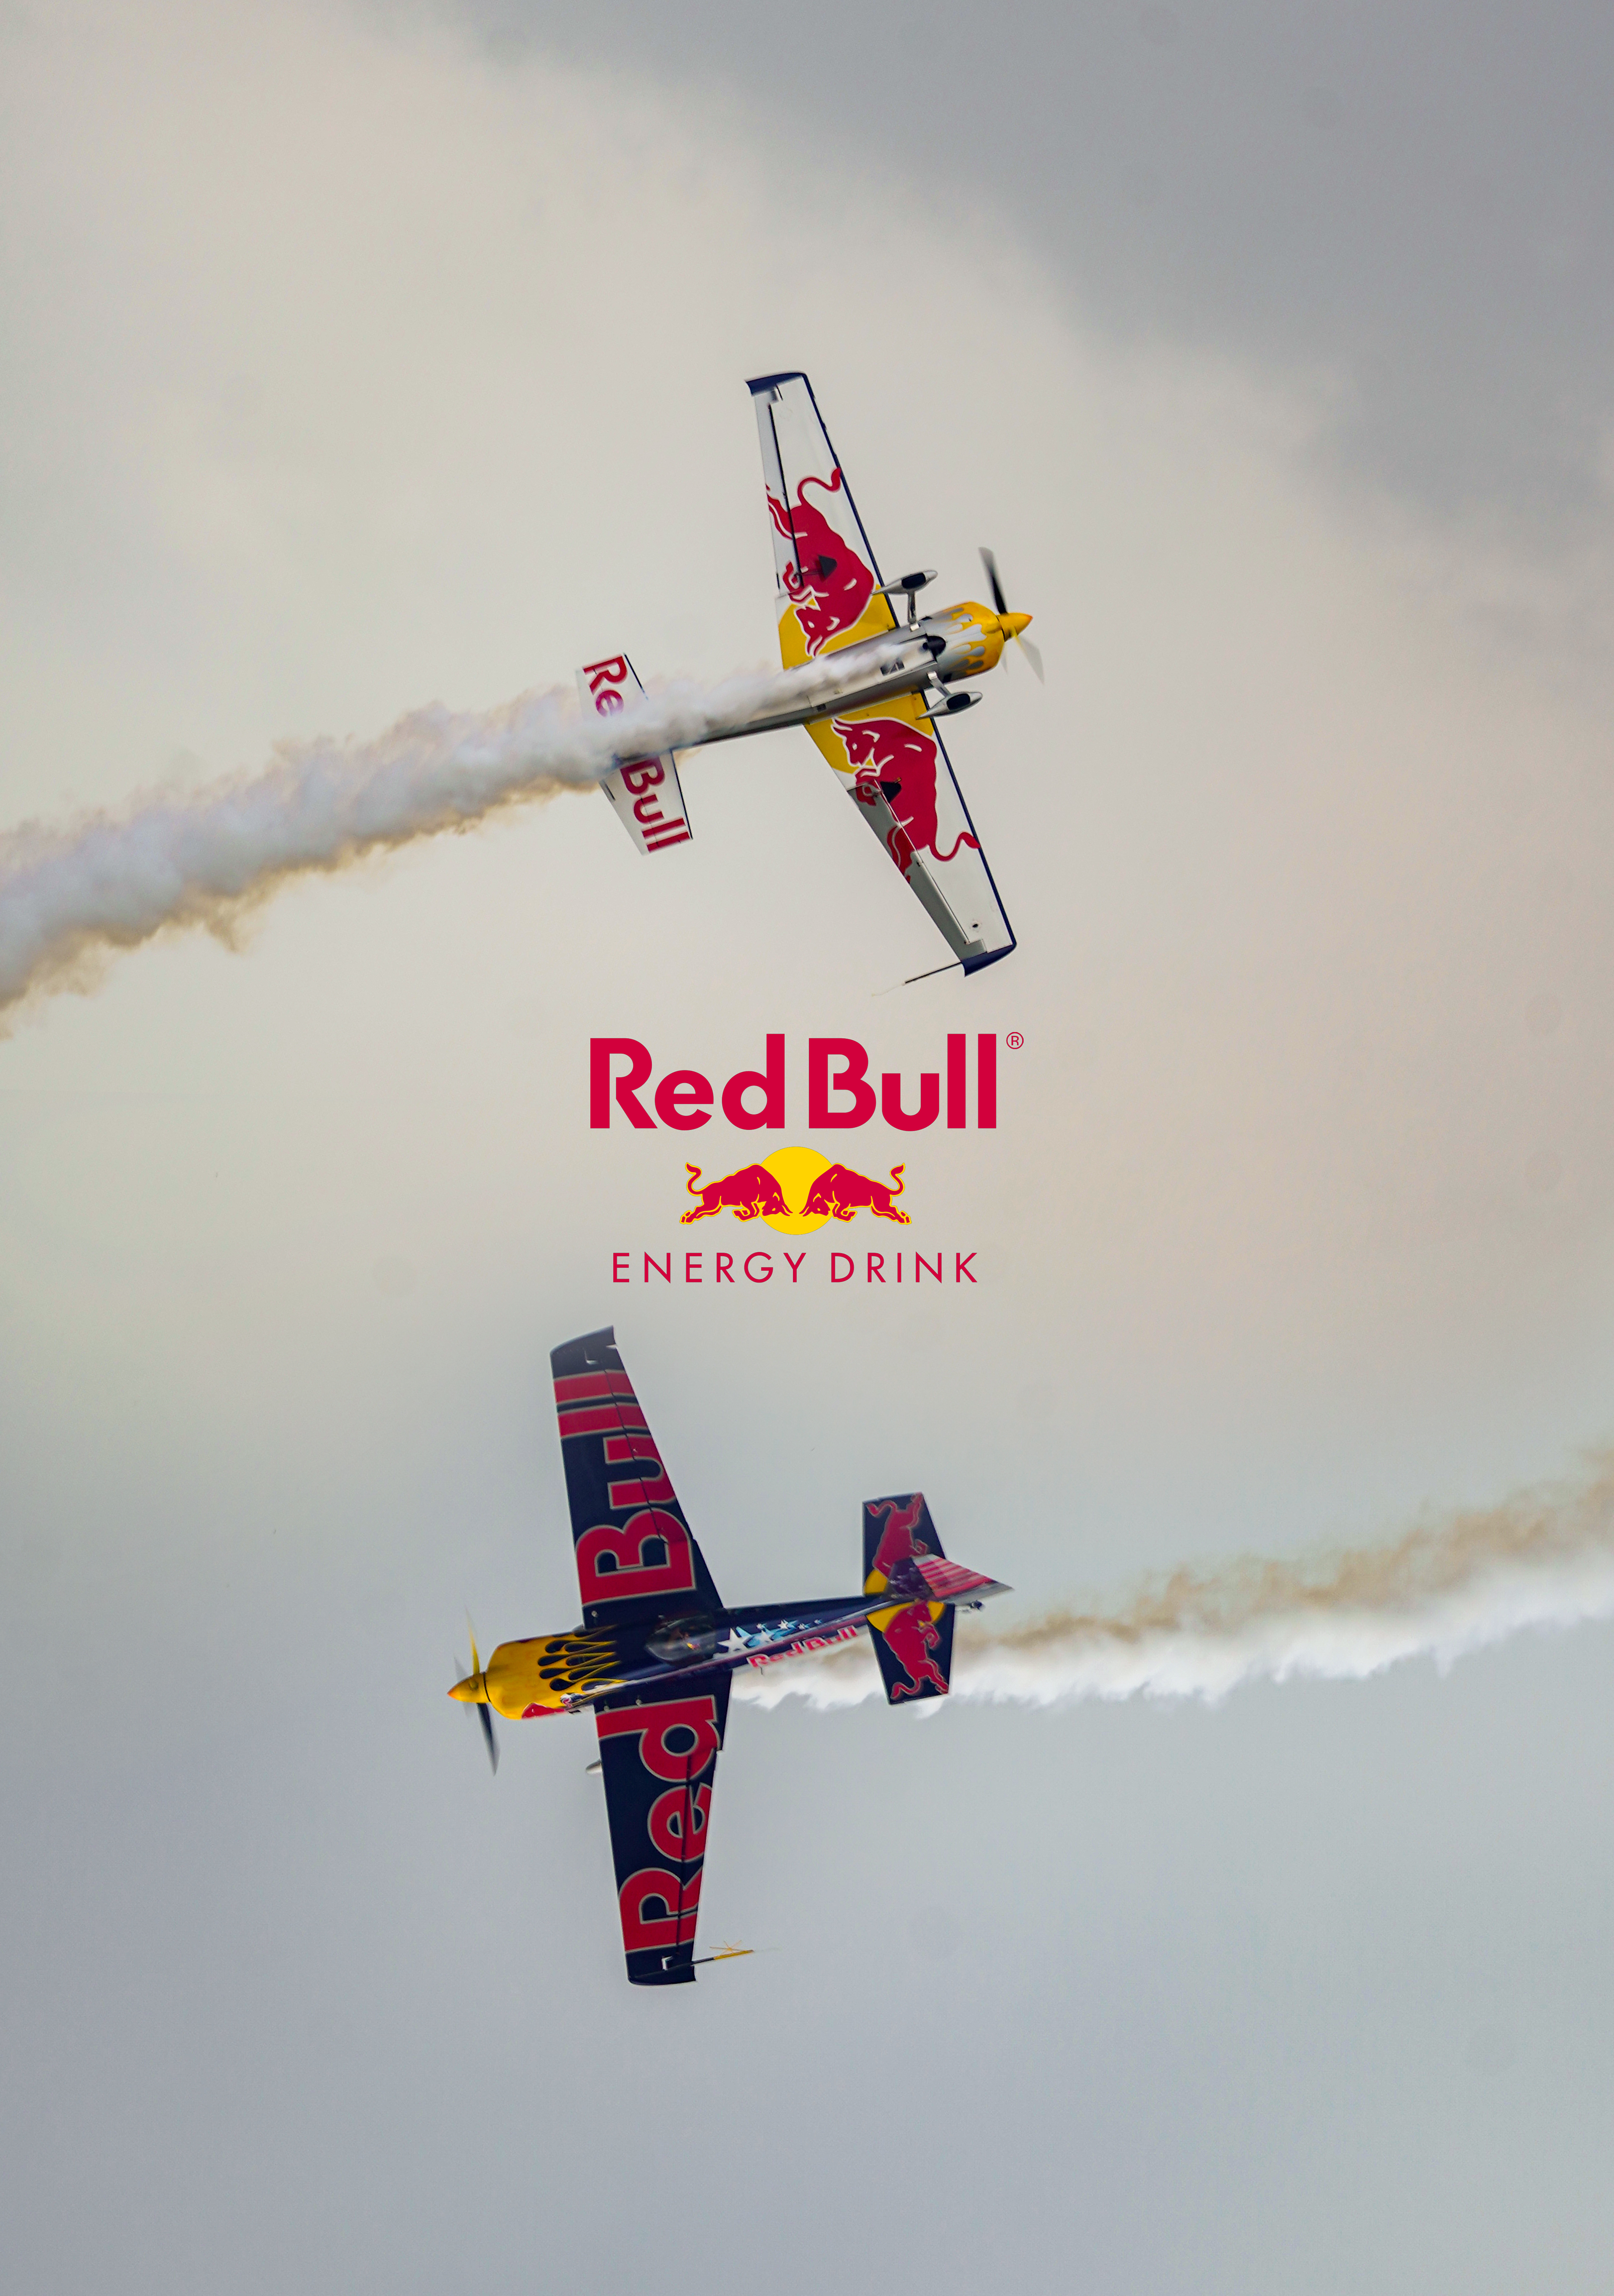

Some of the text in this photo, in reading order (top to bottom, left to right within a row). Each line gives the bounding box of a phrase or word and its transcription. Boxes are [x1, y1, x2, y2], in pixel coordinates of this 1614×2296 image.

[582, 654, 691, 853] Re Bull
[553, 1369, 721, 1953] Red Bull
